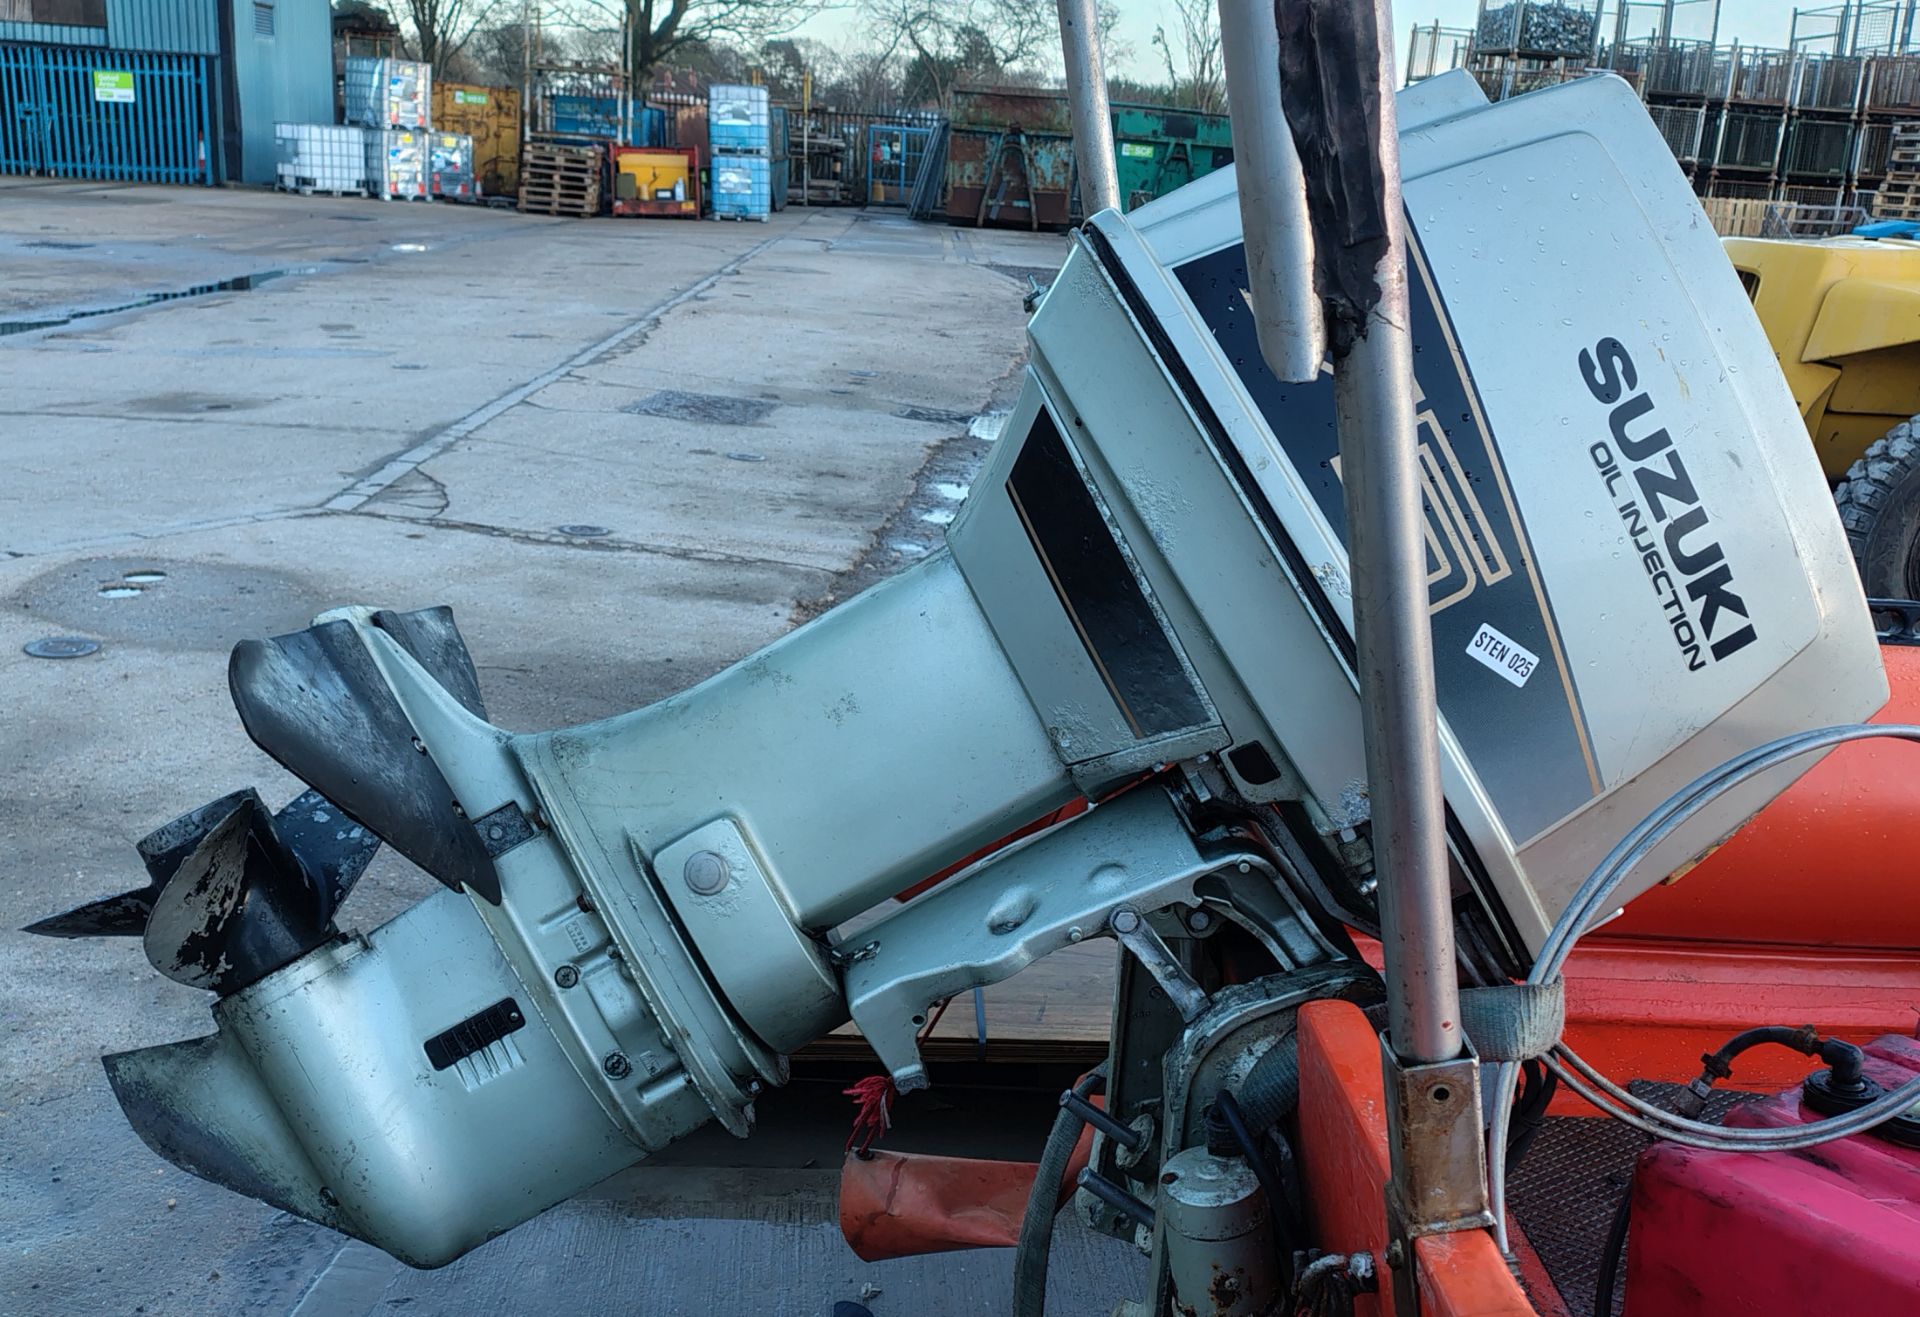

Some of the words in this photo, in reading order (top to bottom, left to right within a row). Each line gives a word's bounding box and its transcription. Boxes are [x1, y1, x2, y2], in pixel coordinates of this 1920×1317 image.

[1578, 337, 1758, 662] SUZUKI
[1589, 441, 1623, 498] OIL
[1618, 500, 1707, 672] INJECTION
[1474, 631, 1510, 663] STEN
[1507, 652, 1534, 678] 025
